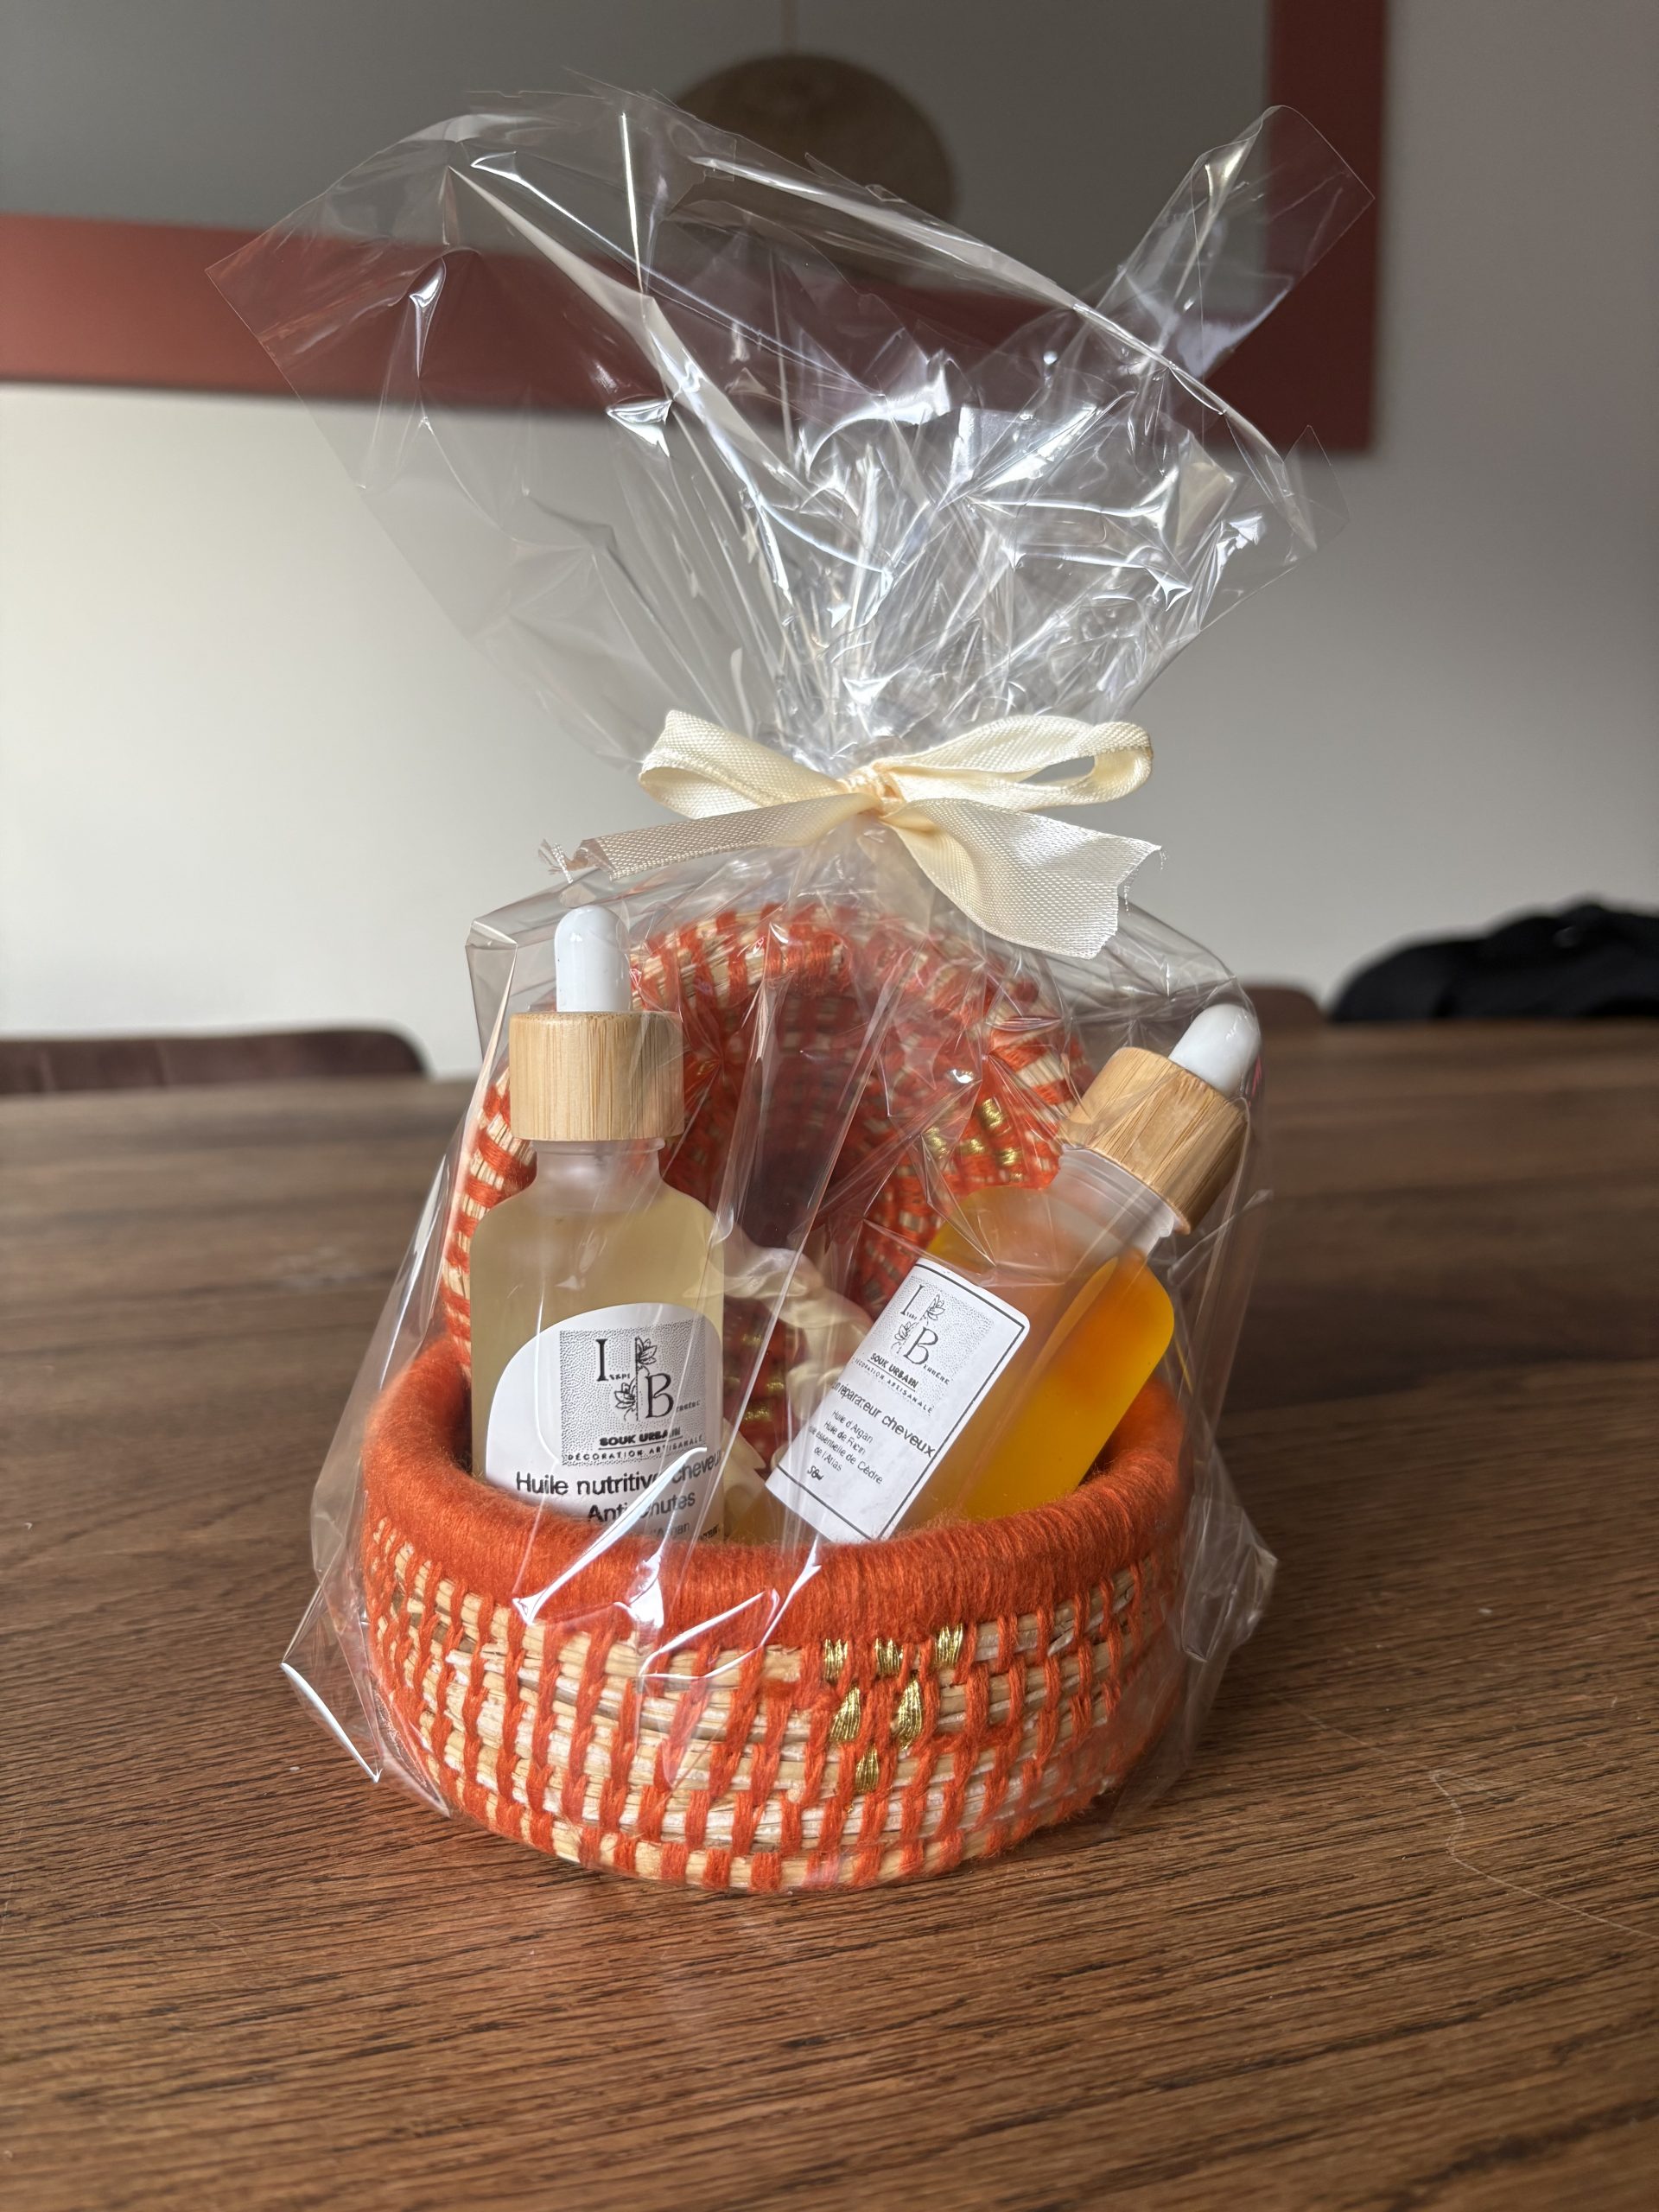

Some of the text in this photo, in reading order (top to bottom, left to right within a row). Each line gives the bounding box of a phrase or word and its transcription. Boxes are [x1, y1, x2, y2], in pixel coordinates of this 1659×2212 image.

[870, 1352, 919, 1389] SOUK URBAIN
[836, 1383, 882, 1418] réparateur
[881, 1414, 936, 1458] cheveux
[599, 1434, 636, 1446] SOUK
[837, 1431, 848, 1441] de
[568, 1449, 643, 1461] DÉCORATION
[814, 1446, 823, 1456] de
[845, 1453, 856, 1465] de
[857, 1460, 883, 1484] Cèdre
[516, 1471, 569, 1495] Huile
